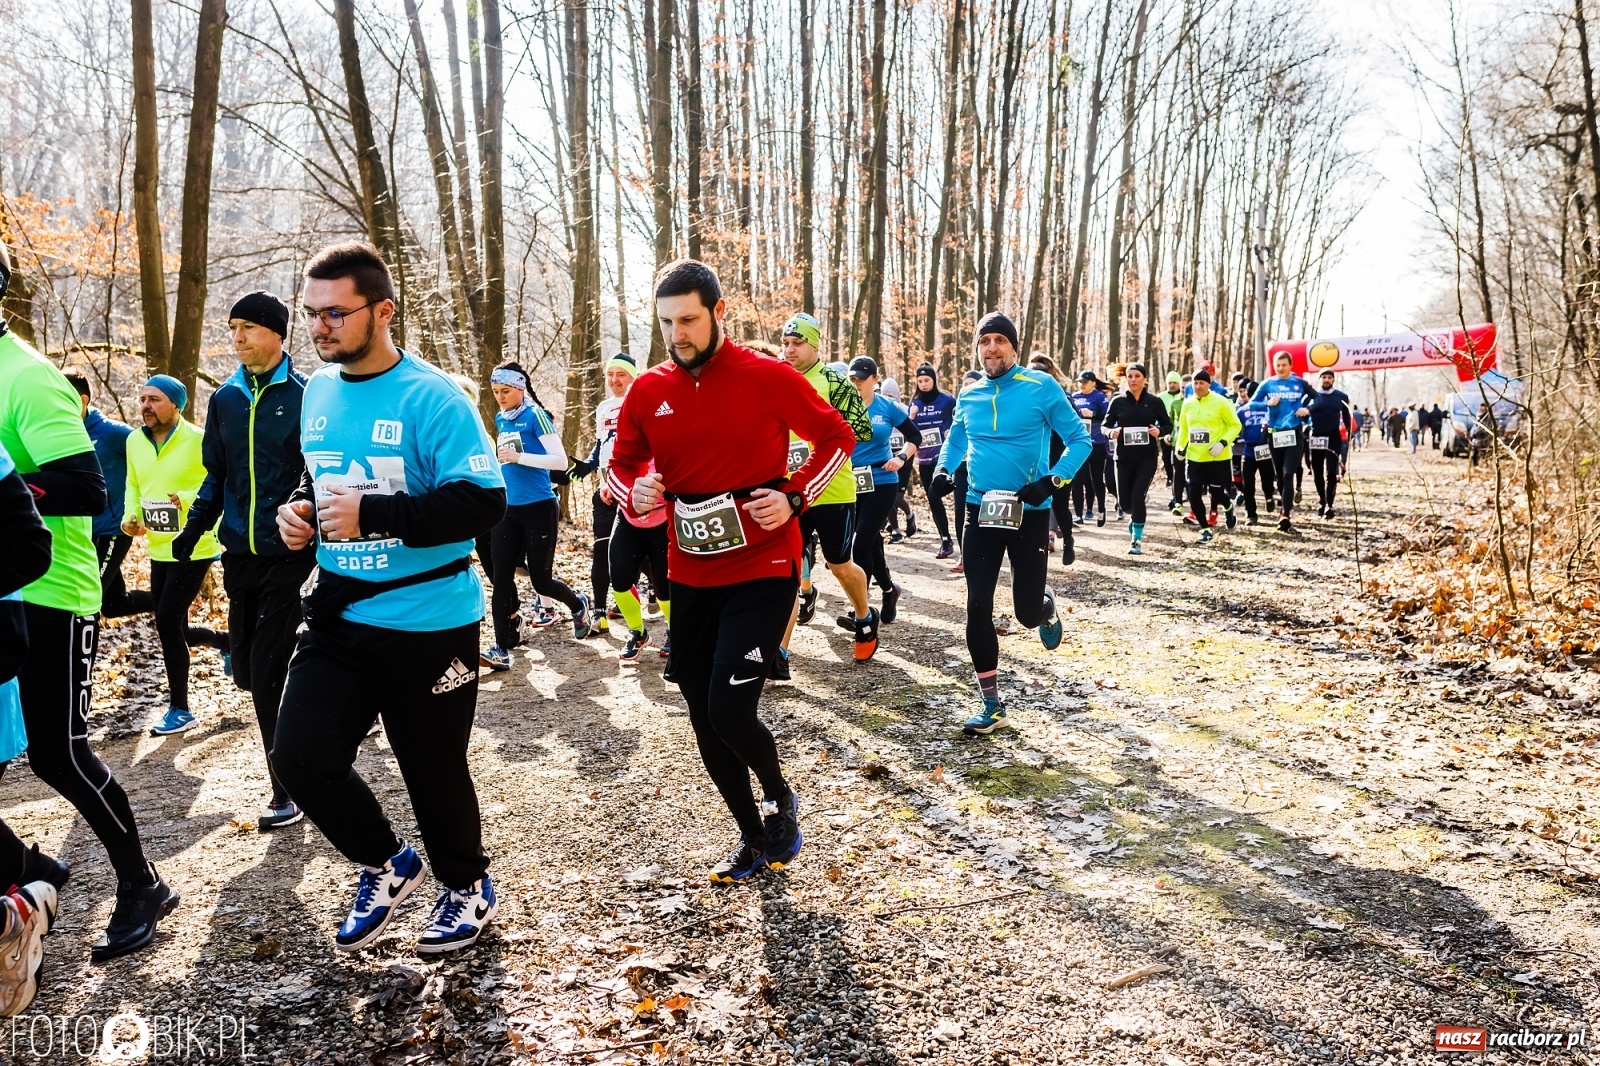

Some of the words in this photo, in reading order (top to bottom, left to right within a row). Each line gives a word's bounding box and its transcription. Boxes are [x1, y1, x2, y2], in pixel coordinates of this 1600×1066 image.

[1366, 337, 1391, 345] BIEG
[1346, 345, 1413, 356] TWARDZIELA
[1353, 356, 1406, 366] RACIBÓRZ
[654, 409, 674, 417] adidas
[377, 423, 398, 441] TBI
[1131, 432, 1143, 440] 112
[472, 458, 489, 469] TBI
[686, 499, 725, 513] Twardziela
[987, 501, 1013, 518] 071
[145, 509, 170, 525] 048
[681, 517, 726, 540] 083
[336, 553, 389, 570] 2022
[431, 671, 476, 694] adidas
